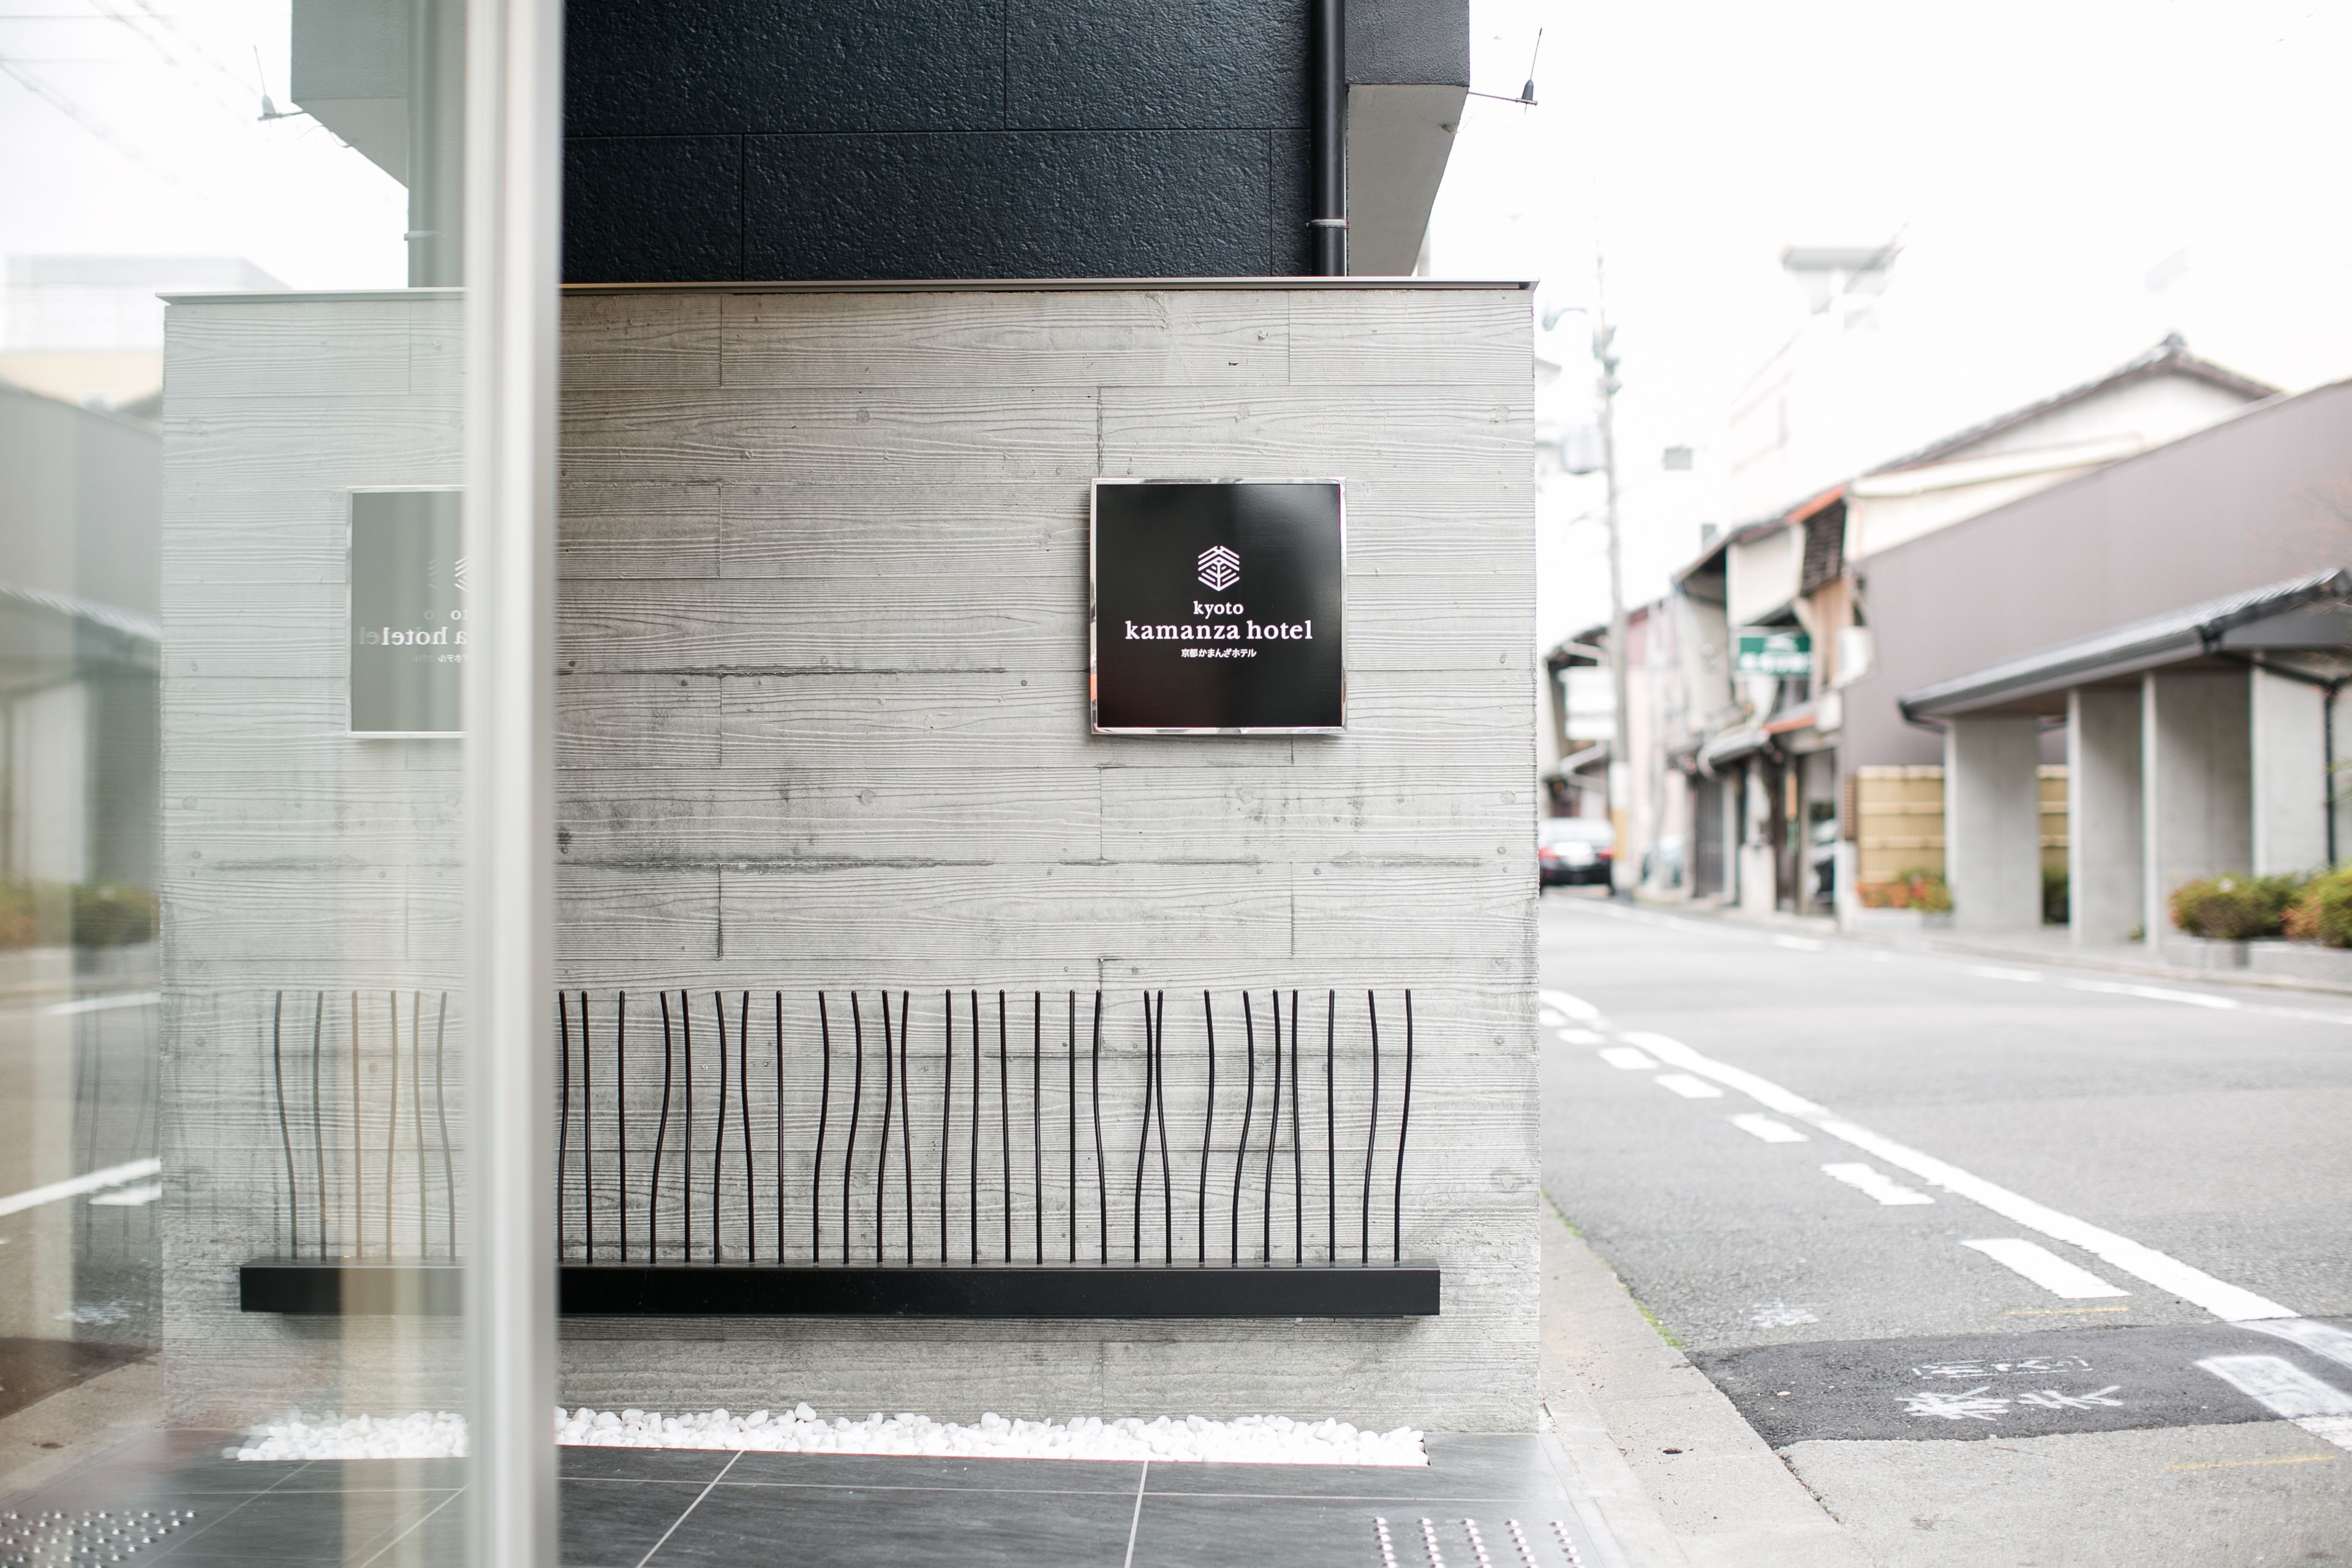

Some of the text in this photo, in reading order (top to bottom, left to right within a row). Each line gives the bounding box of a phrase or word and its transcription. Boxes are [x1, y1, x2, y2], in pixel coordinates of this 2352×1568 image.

[1193, 601, 1243, 619] kyoto
[1125, 620, 1313, 639] kamanza hotel
[1181, 648, 1257, 658] 京都かまんざホテル
